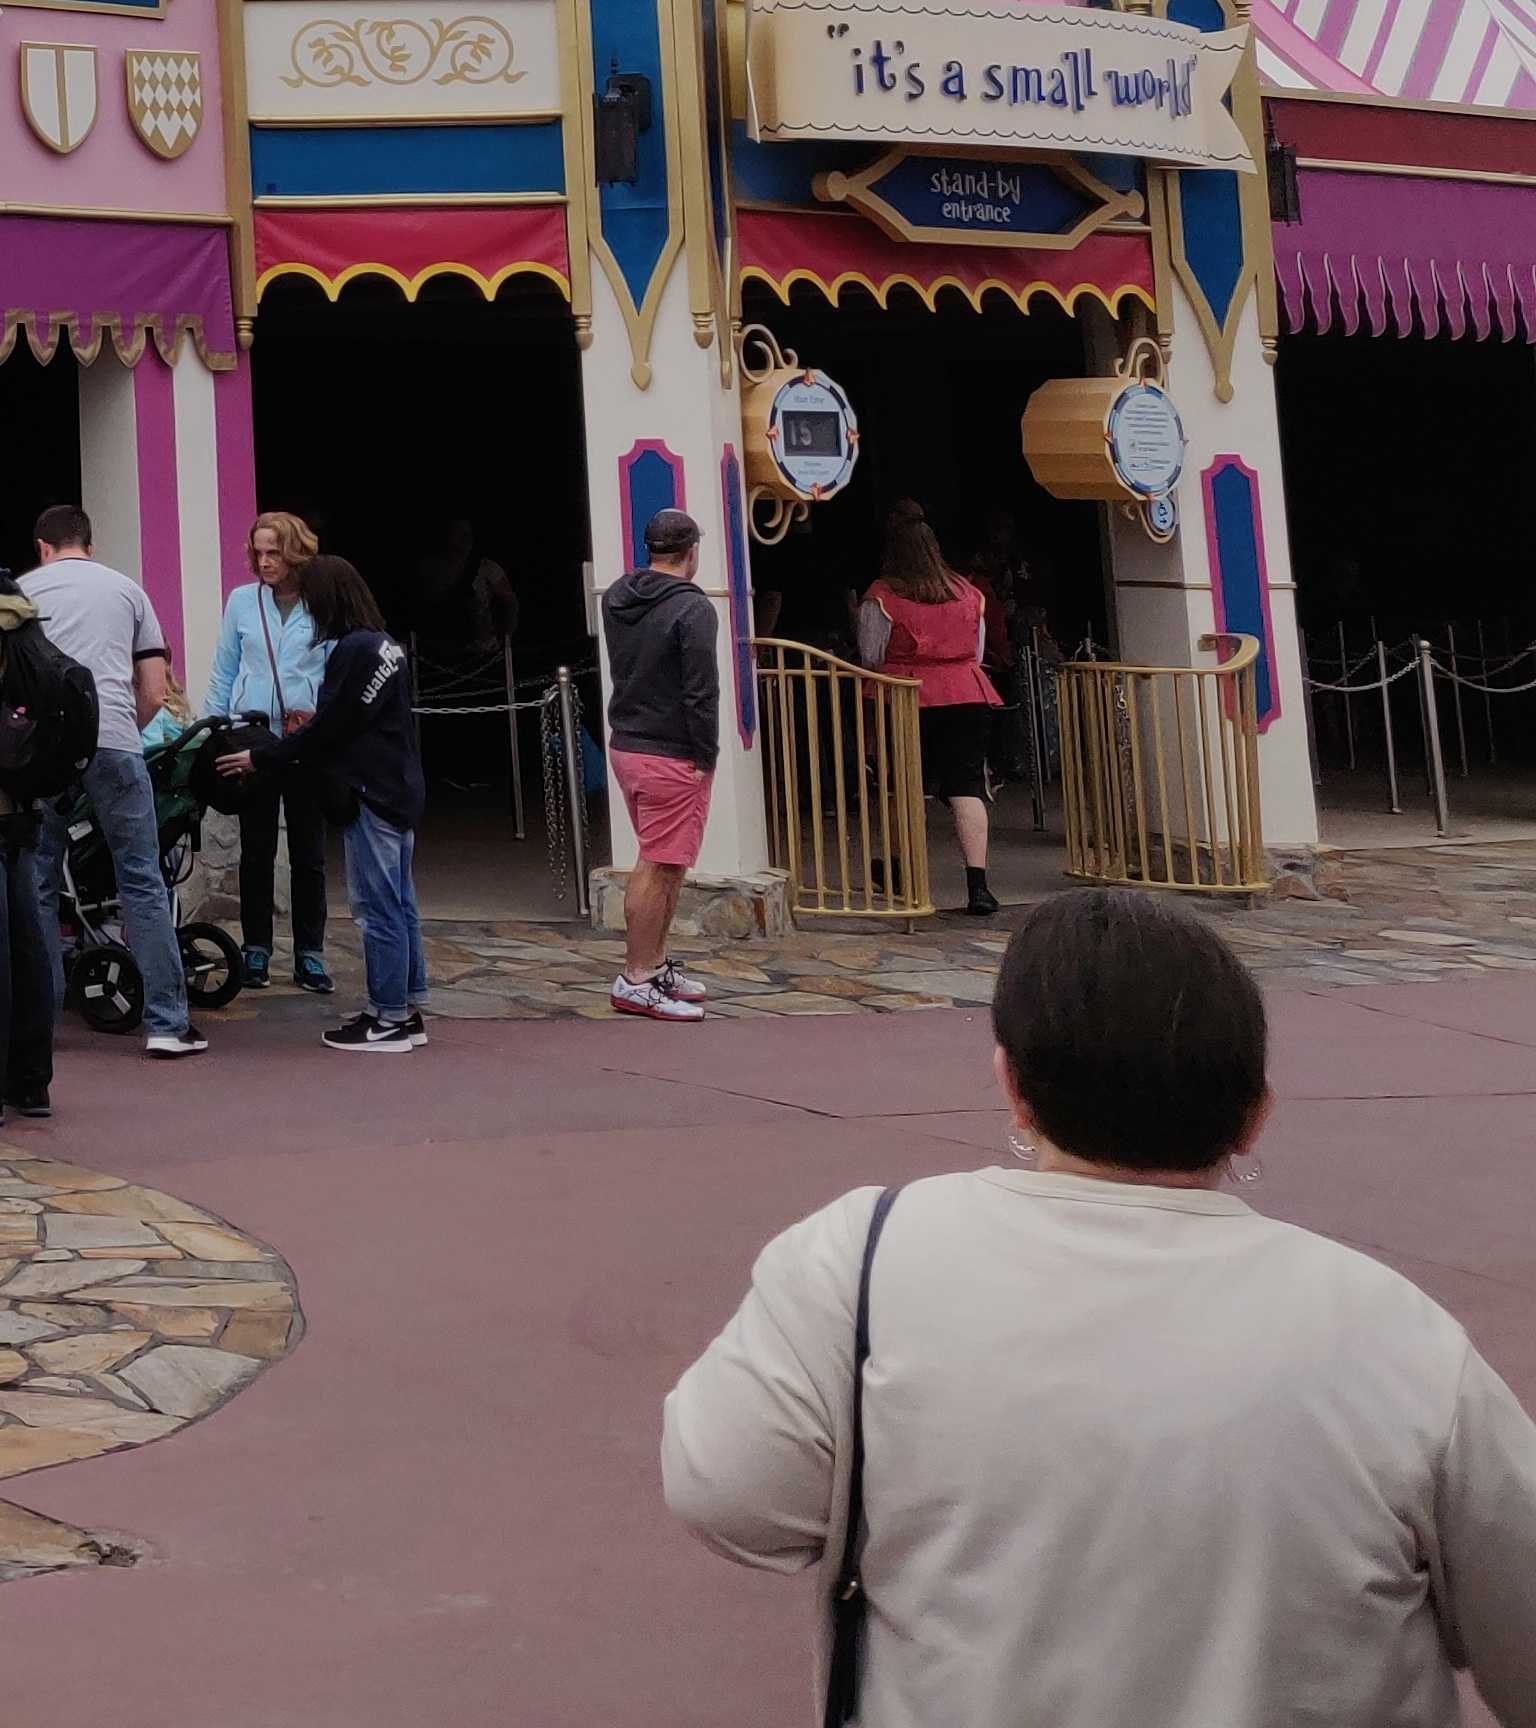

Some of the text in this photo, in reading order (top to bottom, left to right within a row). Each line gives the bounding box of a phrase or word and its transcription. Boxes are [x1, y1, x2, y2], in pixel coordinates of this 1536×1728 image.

[940, 59, 968, 102] a
[981, 47, 1098, 114] small
[930, 168, 1021, 205] stand-by
[941, 200, 1012, 223] entrance
